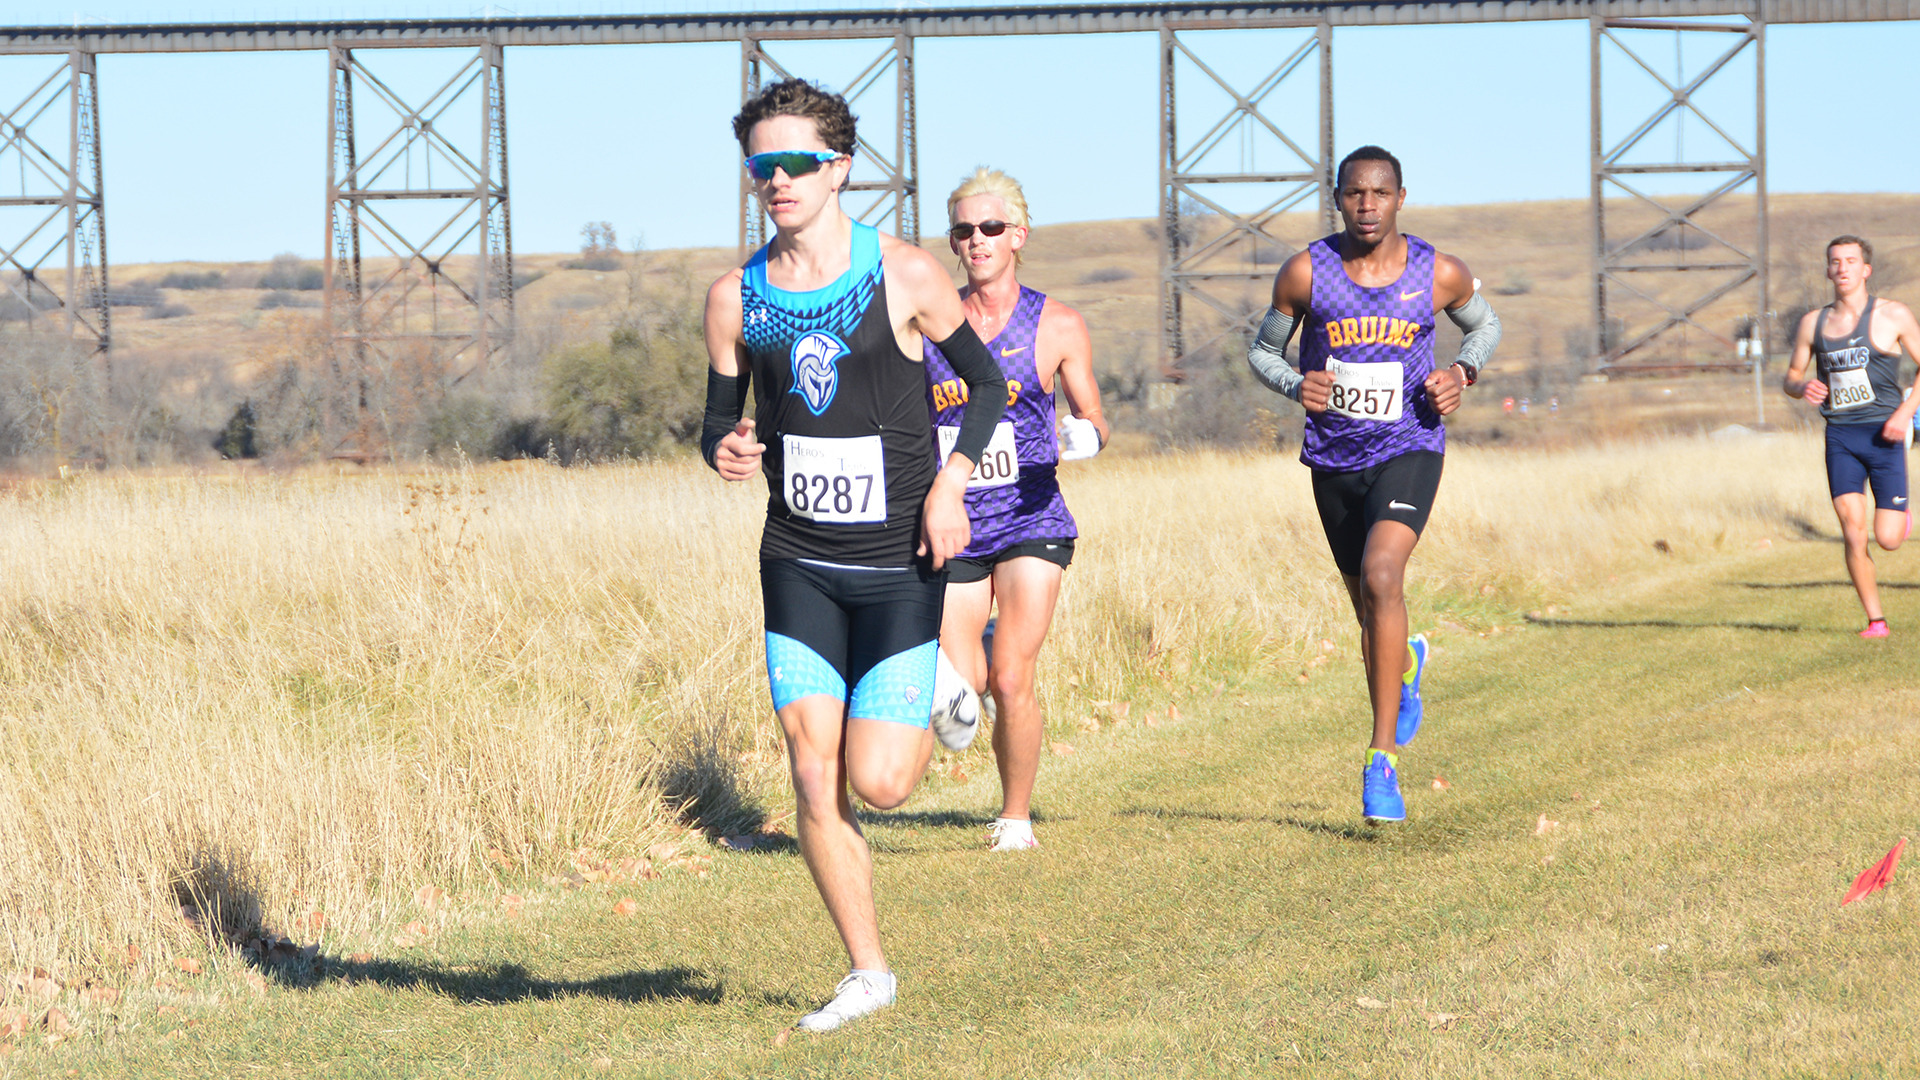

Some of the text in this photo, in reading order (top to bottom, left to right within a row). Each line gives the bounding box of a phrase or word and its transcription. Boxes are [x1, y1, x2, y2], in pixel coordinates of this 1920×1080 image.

[1325, 315, 1420, 348] BRUINS
[1332, 384, 1395, 415] 8257
[1833, 385, 1870, 405] 8308
[791, 472, 873, 514] 8287
